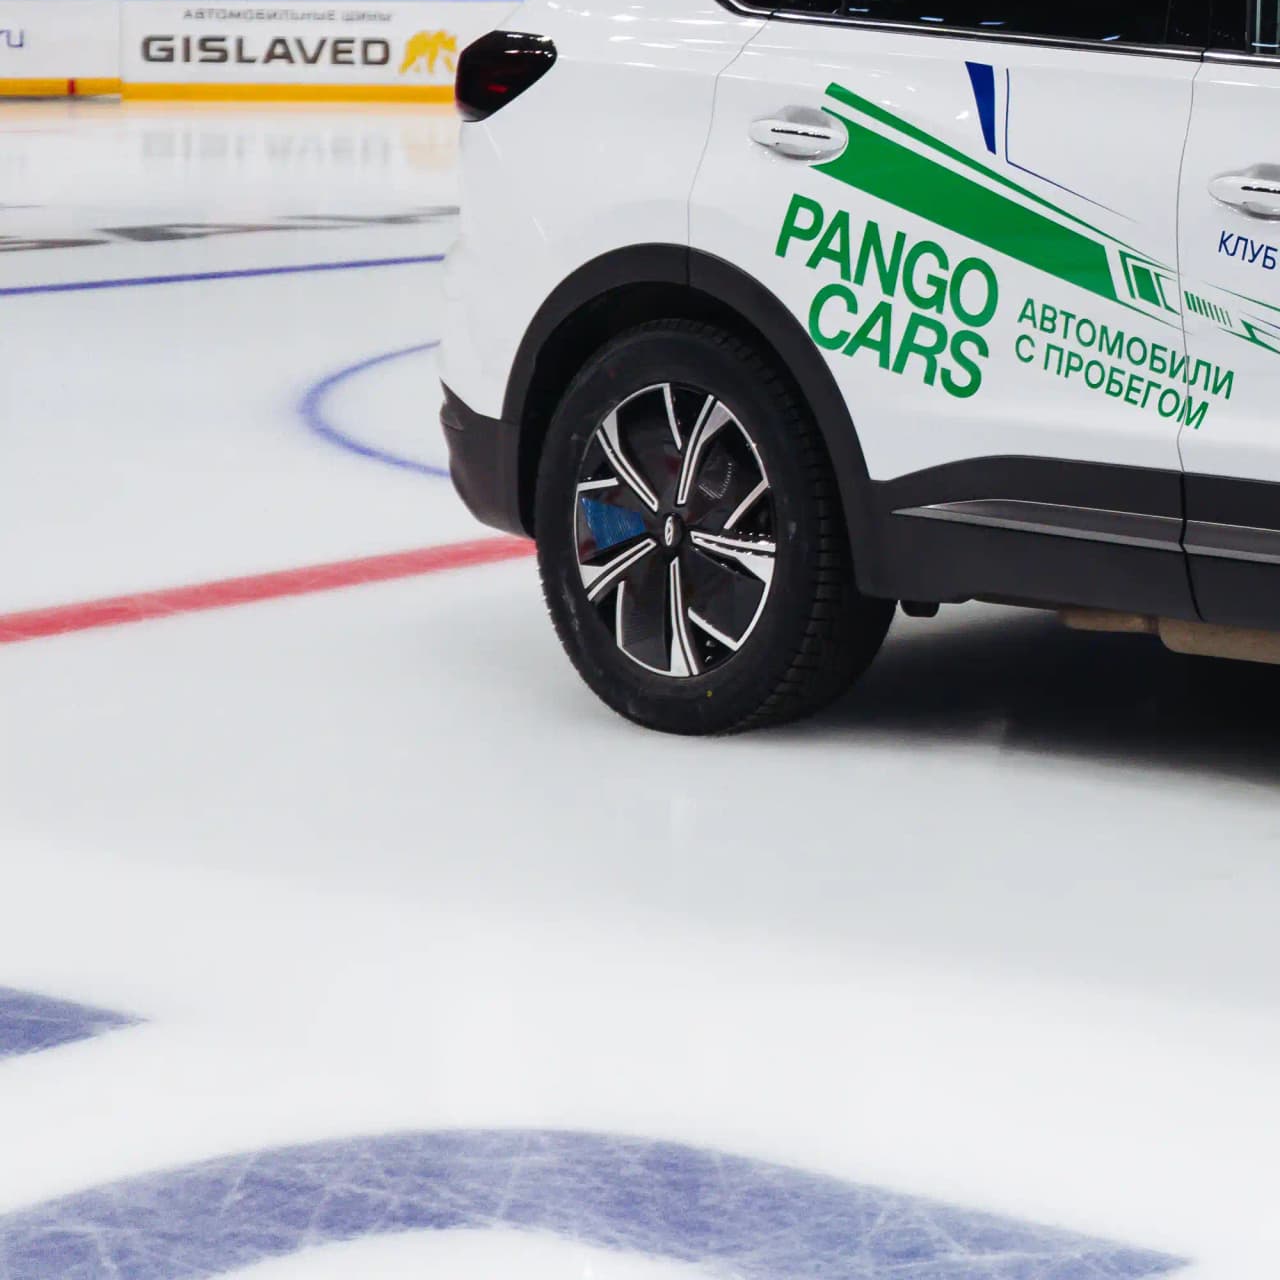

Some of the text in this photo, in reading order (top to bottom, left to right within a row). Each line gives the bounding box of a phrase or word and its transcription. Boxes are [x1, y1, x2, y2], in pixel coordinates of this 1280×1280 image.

[141, 33, 391, 66] GISLAVED
[775, 192, 1000, 329] PANGO
[1217, 230, 1279, 272] КЛУБ
[808, 283, 989, 399] CARS
[1014, 334, 1209, 431] С ПРОБЕГОМ
[1017, 297, 1235, 401] АВТОМОБИЛИ
